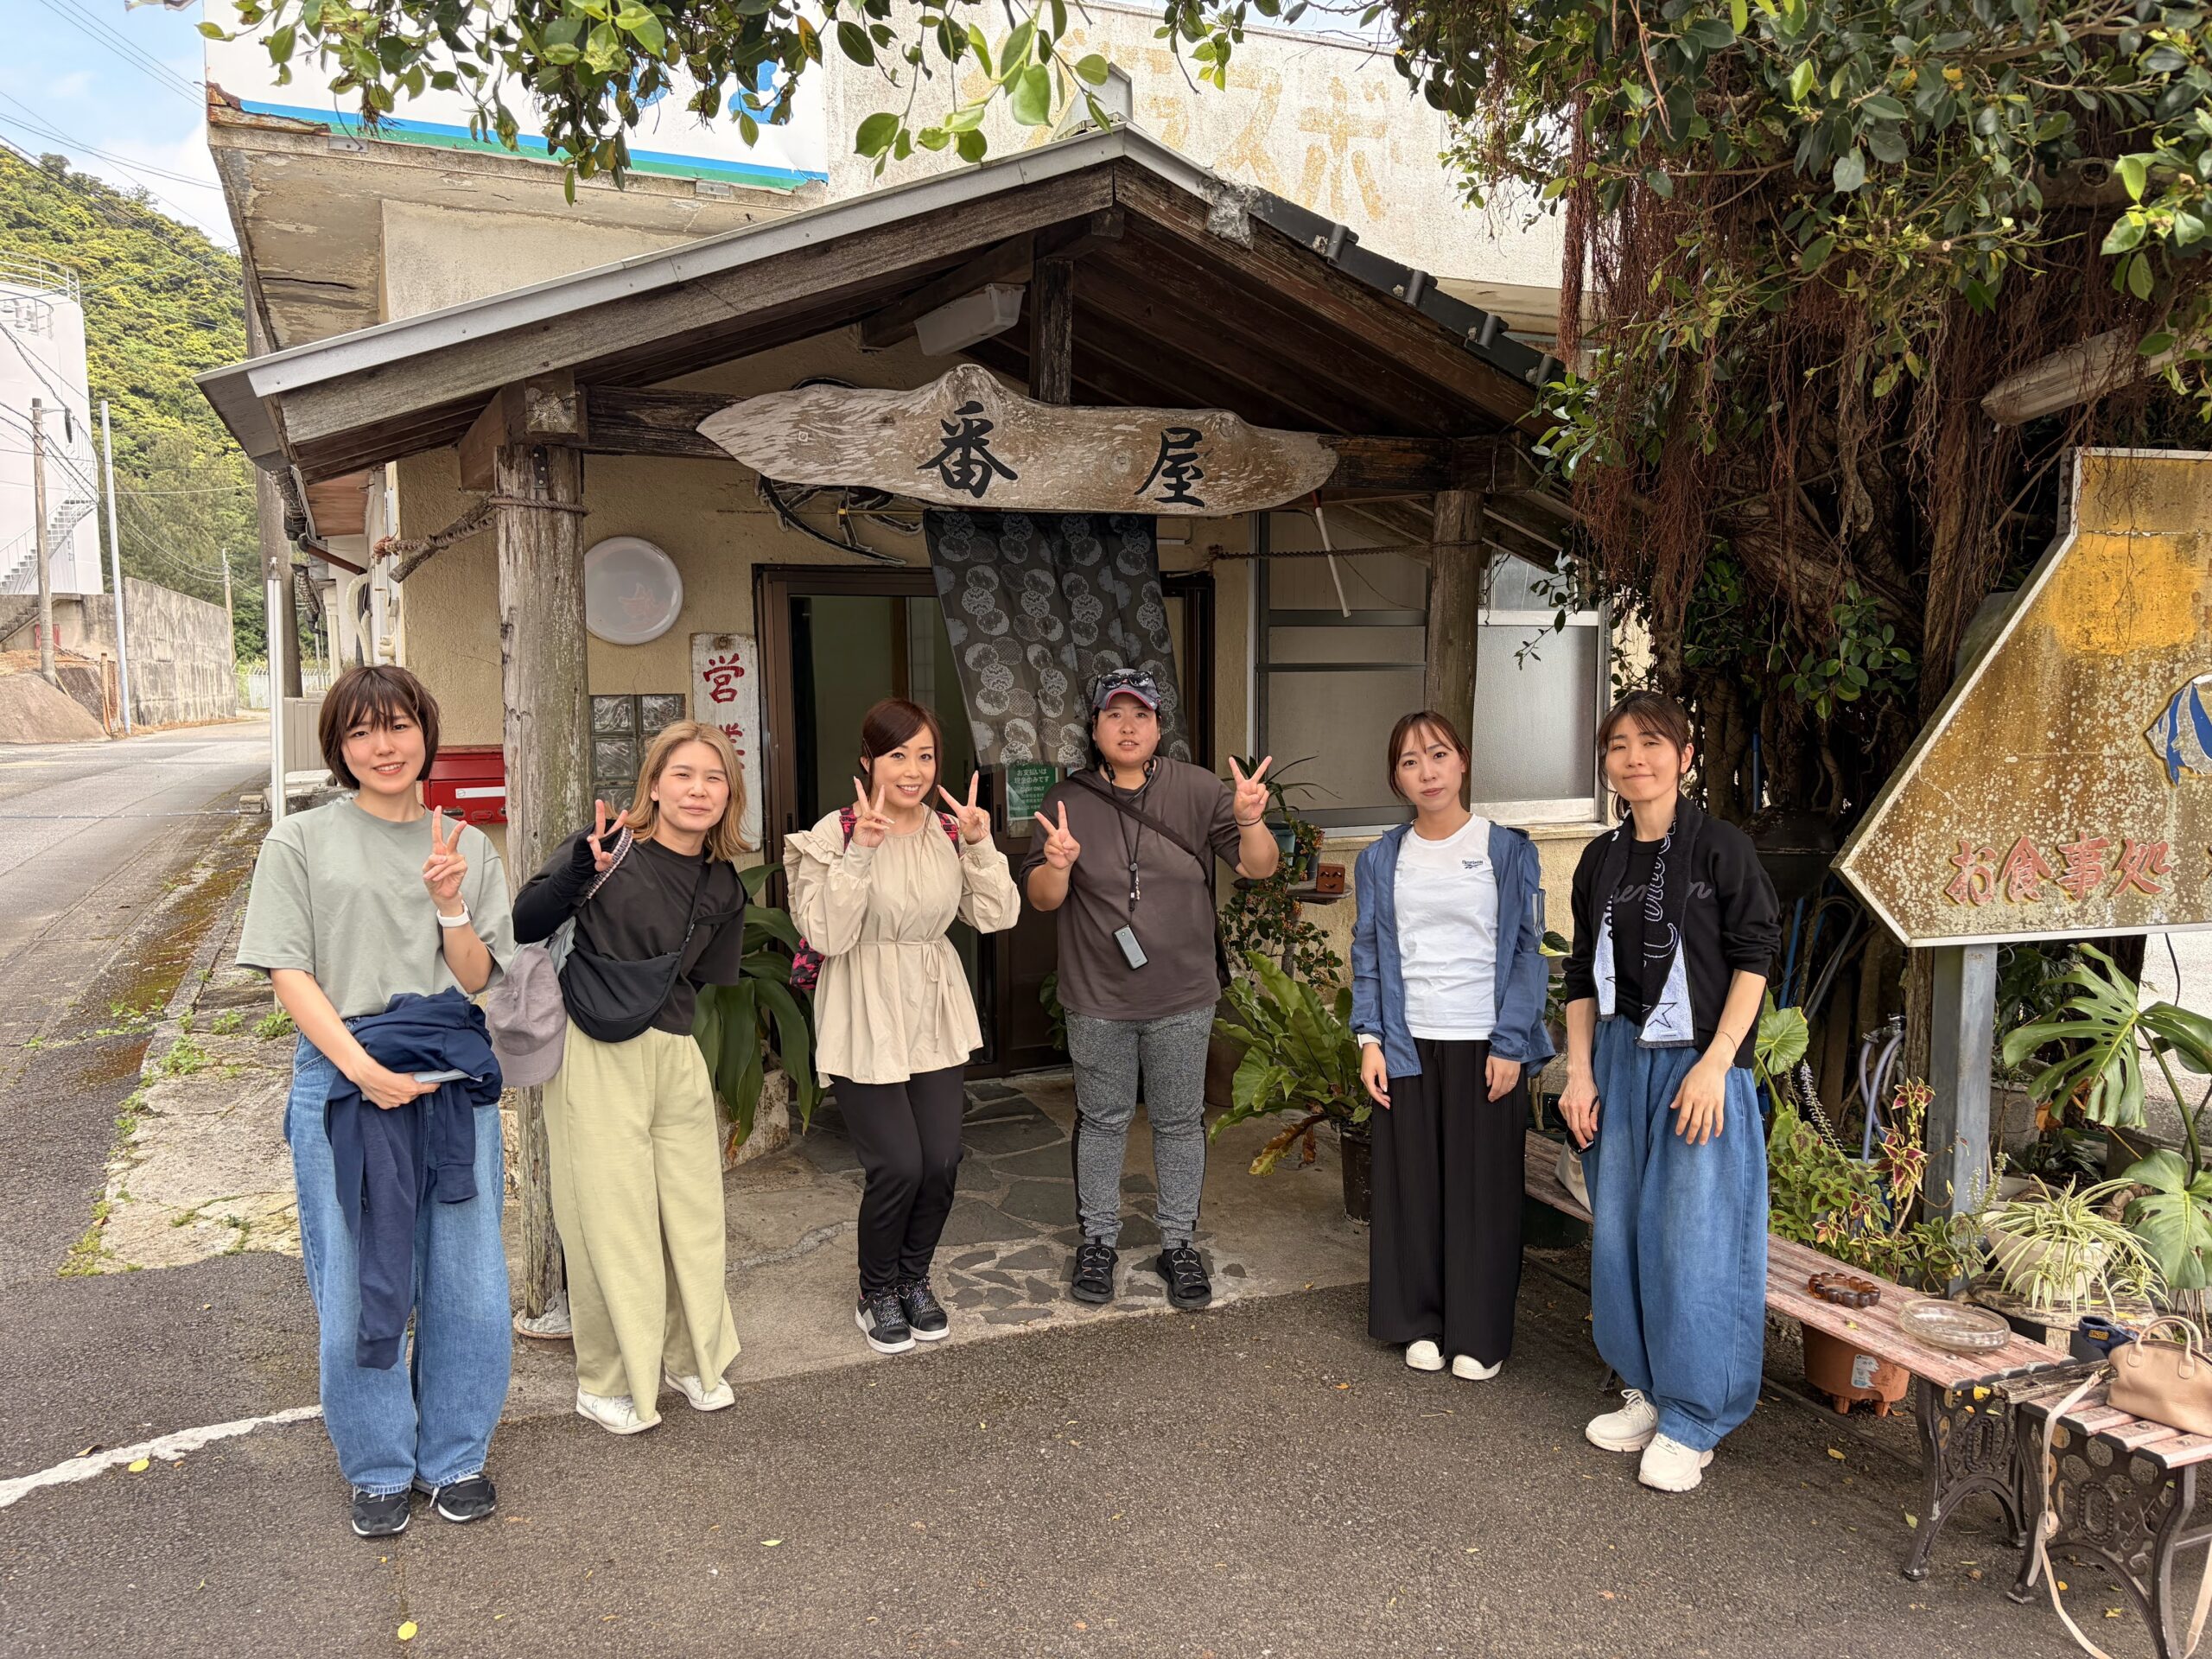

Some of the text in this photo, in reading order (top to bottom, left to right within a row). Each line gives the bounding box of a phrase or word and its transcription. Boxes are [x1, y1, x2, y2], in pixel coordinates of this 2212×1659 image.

[917, 400, 1206, 507] 番屋
[1945, 830, 2175, 906] お食事処
